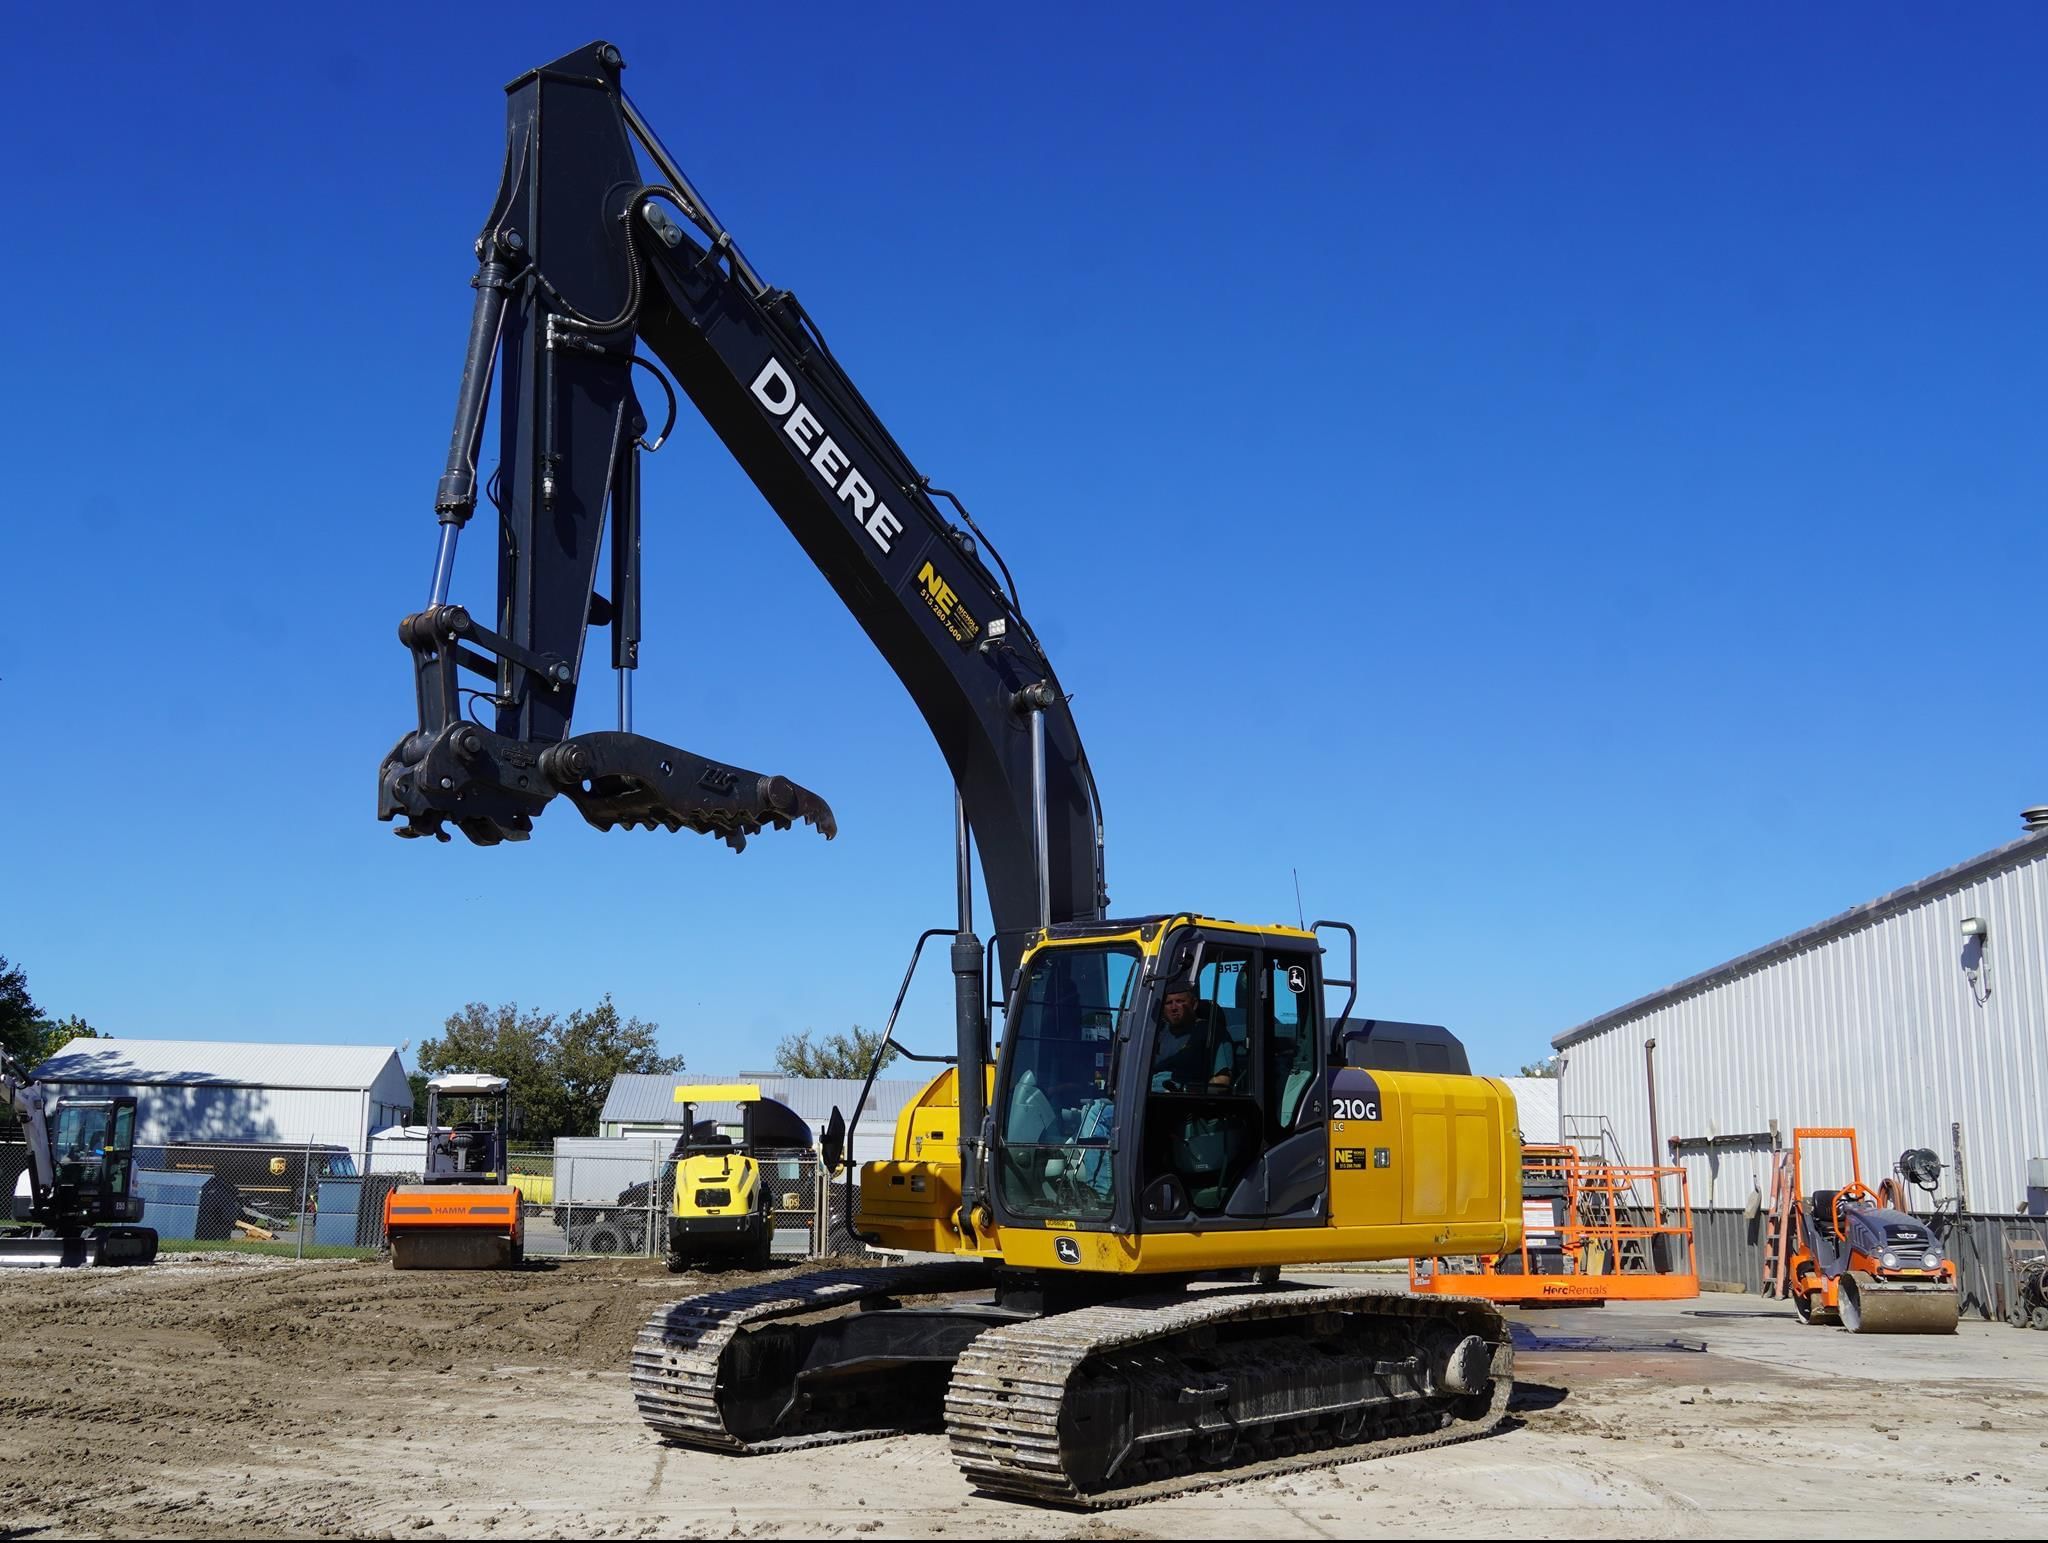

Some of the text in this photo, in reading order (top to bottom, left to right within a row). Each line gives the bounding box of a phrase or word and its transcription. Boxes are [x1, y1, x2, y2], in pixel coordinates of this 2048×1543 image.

[750, 356, 903, 554] DEERE
[917, 561, 958, 616] NE
[920, 588, 962, 641] 515.280.7600
[1332, 1099, 1377, 1120] 210G
[1333, 1122, 1344, 1132] LC
[1335, 1150, 1353, 1163] NE
